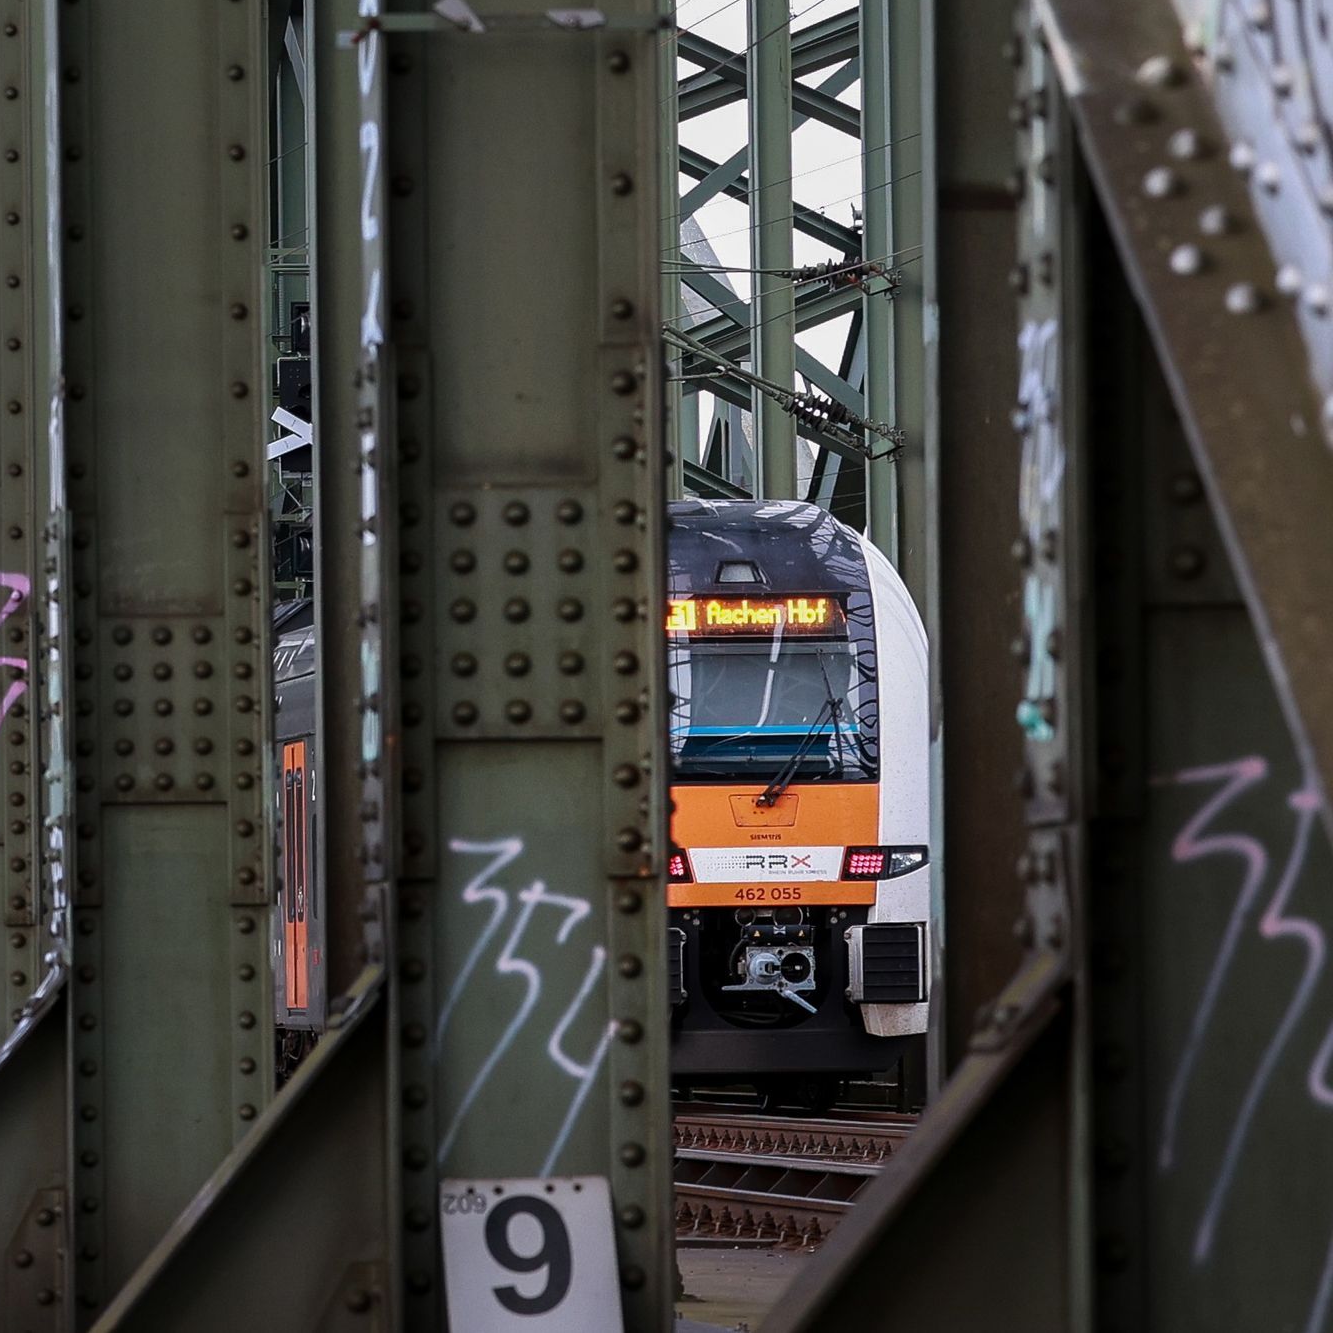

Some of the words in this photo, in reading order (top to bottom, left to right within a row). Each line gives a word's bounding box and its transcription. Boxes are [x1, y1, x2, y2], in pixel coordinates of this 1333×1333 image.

[706, 599, 782, 625] Aachen
[786, 598, 827, 624] Hbf
[746, 855, 811, 869] RRX
[735, 888, 766, 901] 462
[771, 888, 802, 900] 055
[485, 1195, 573, 1317] 9
